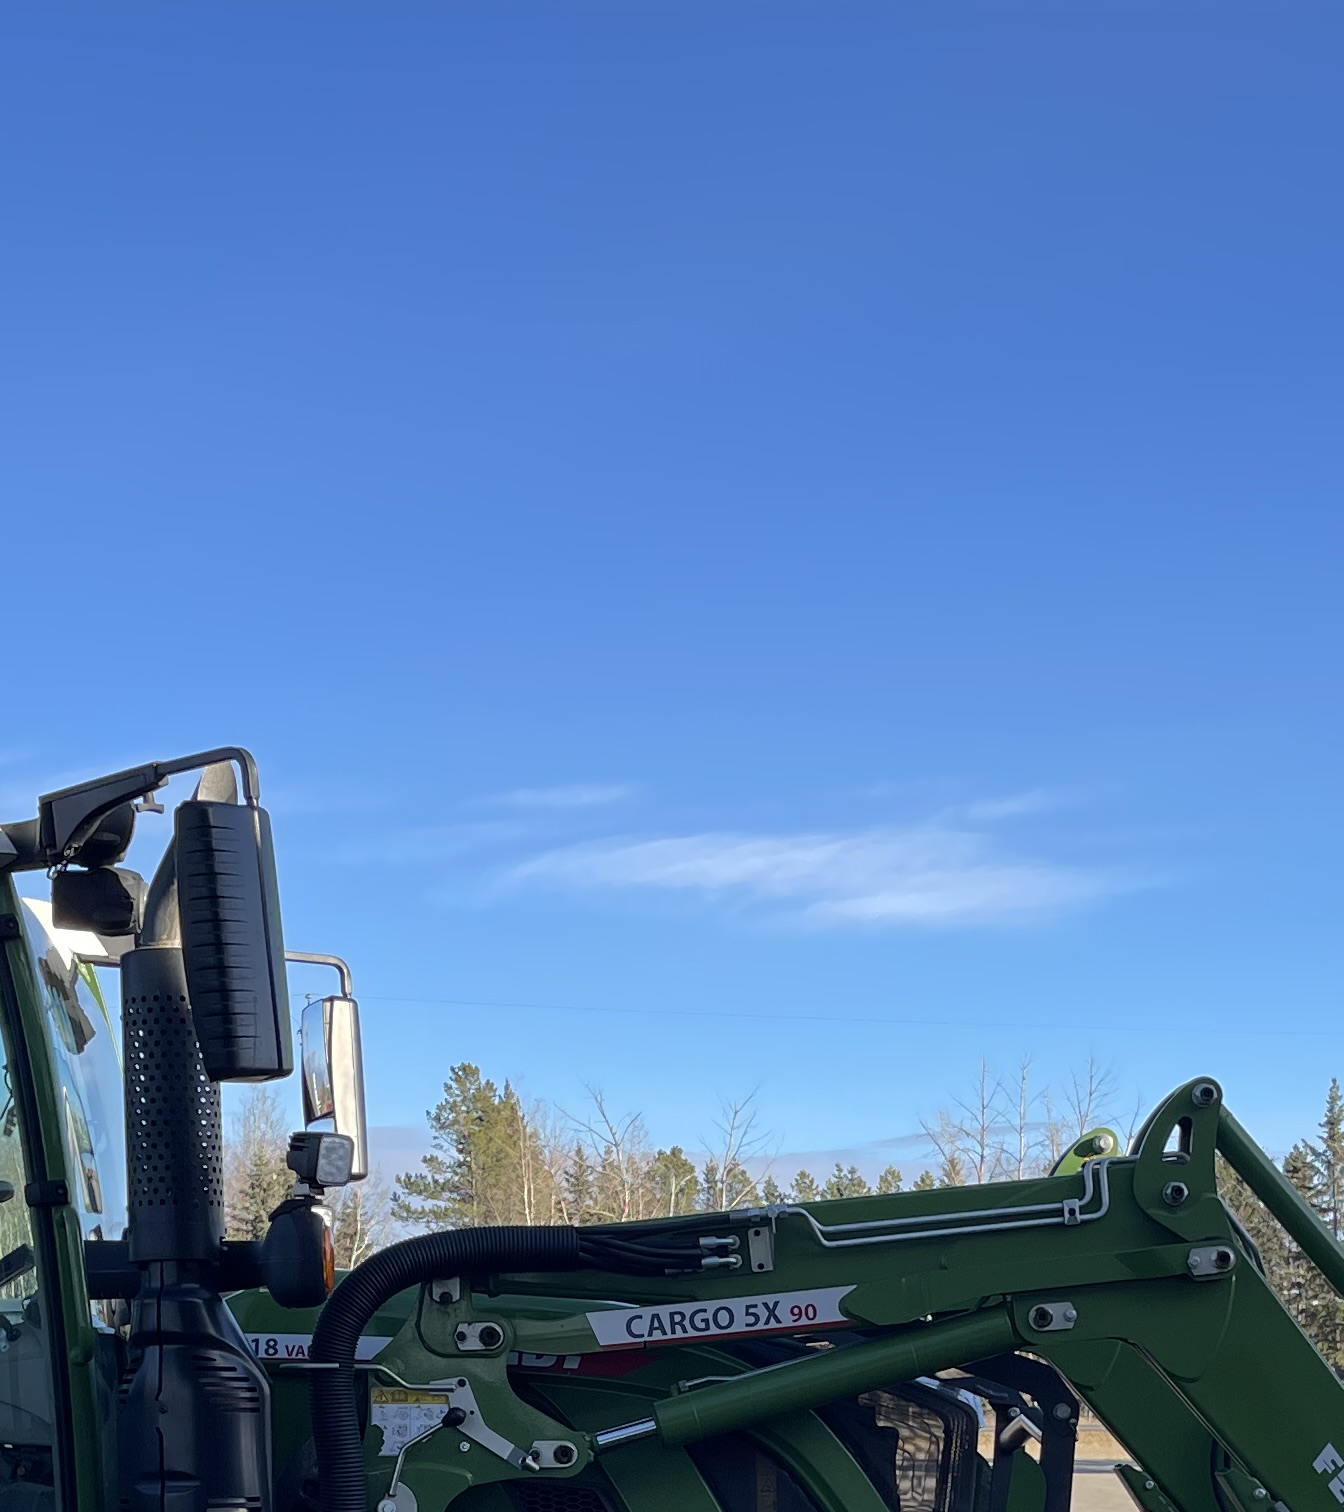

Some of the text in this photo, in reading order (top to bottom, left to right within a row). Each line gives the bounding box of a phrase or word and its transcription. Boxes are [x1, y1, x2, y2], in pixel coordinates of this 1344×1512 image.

[625, 1300, 817, 1339] CARGO 5X 90
